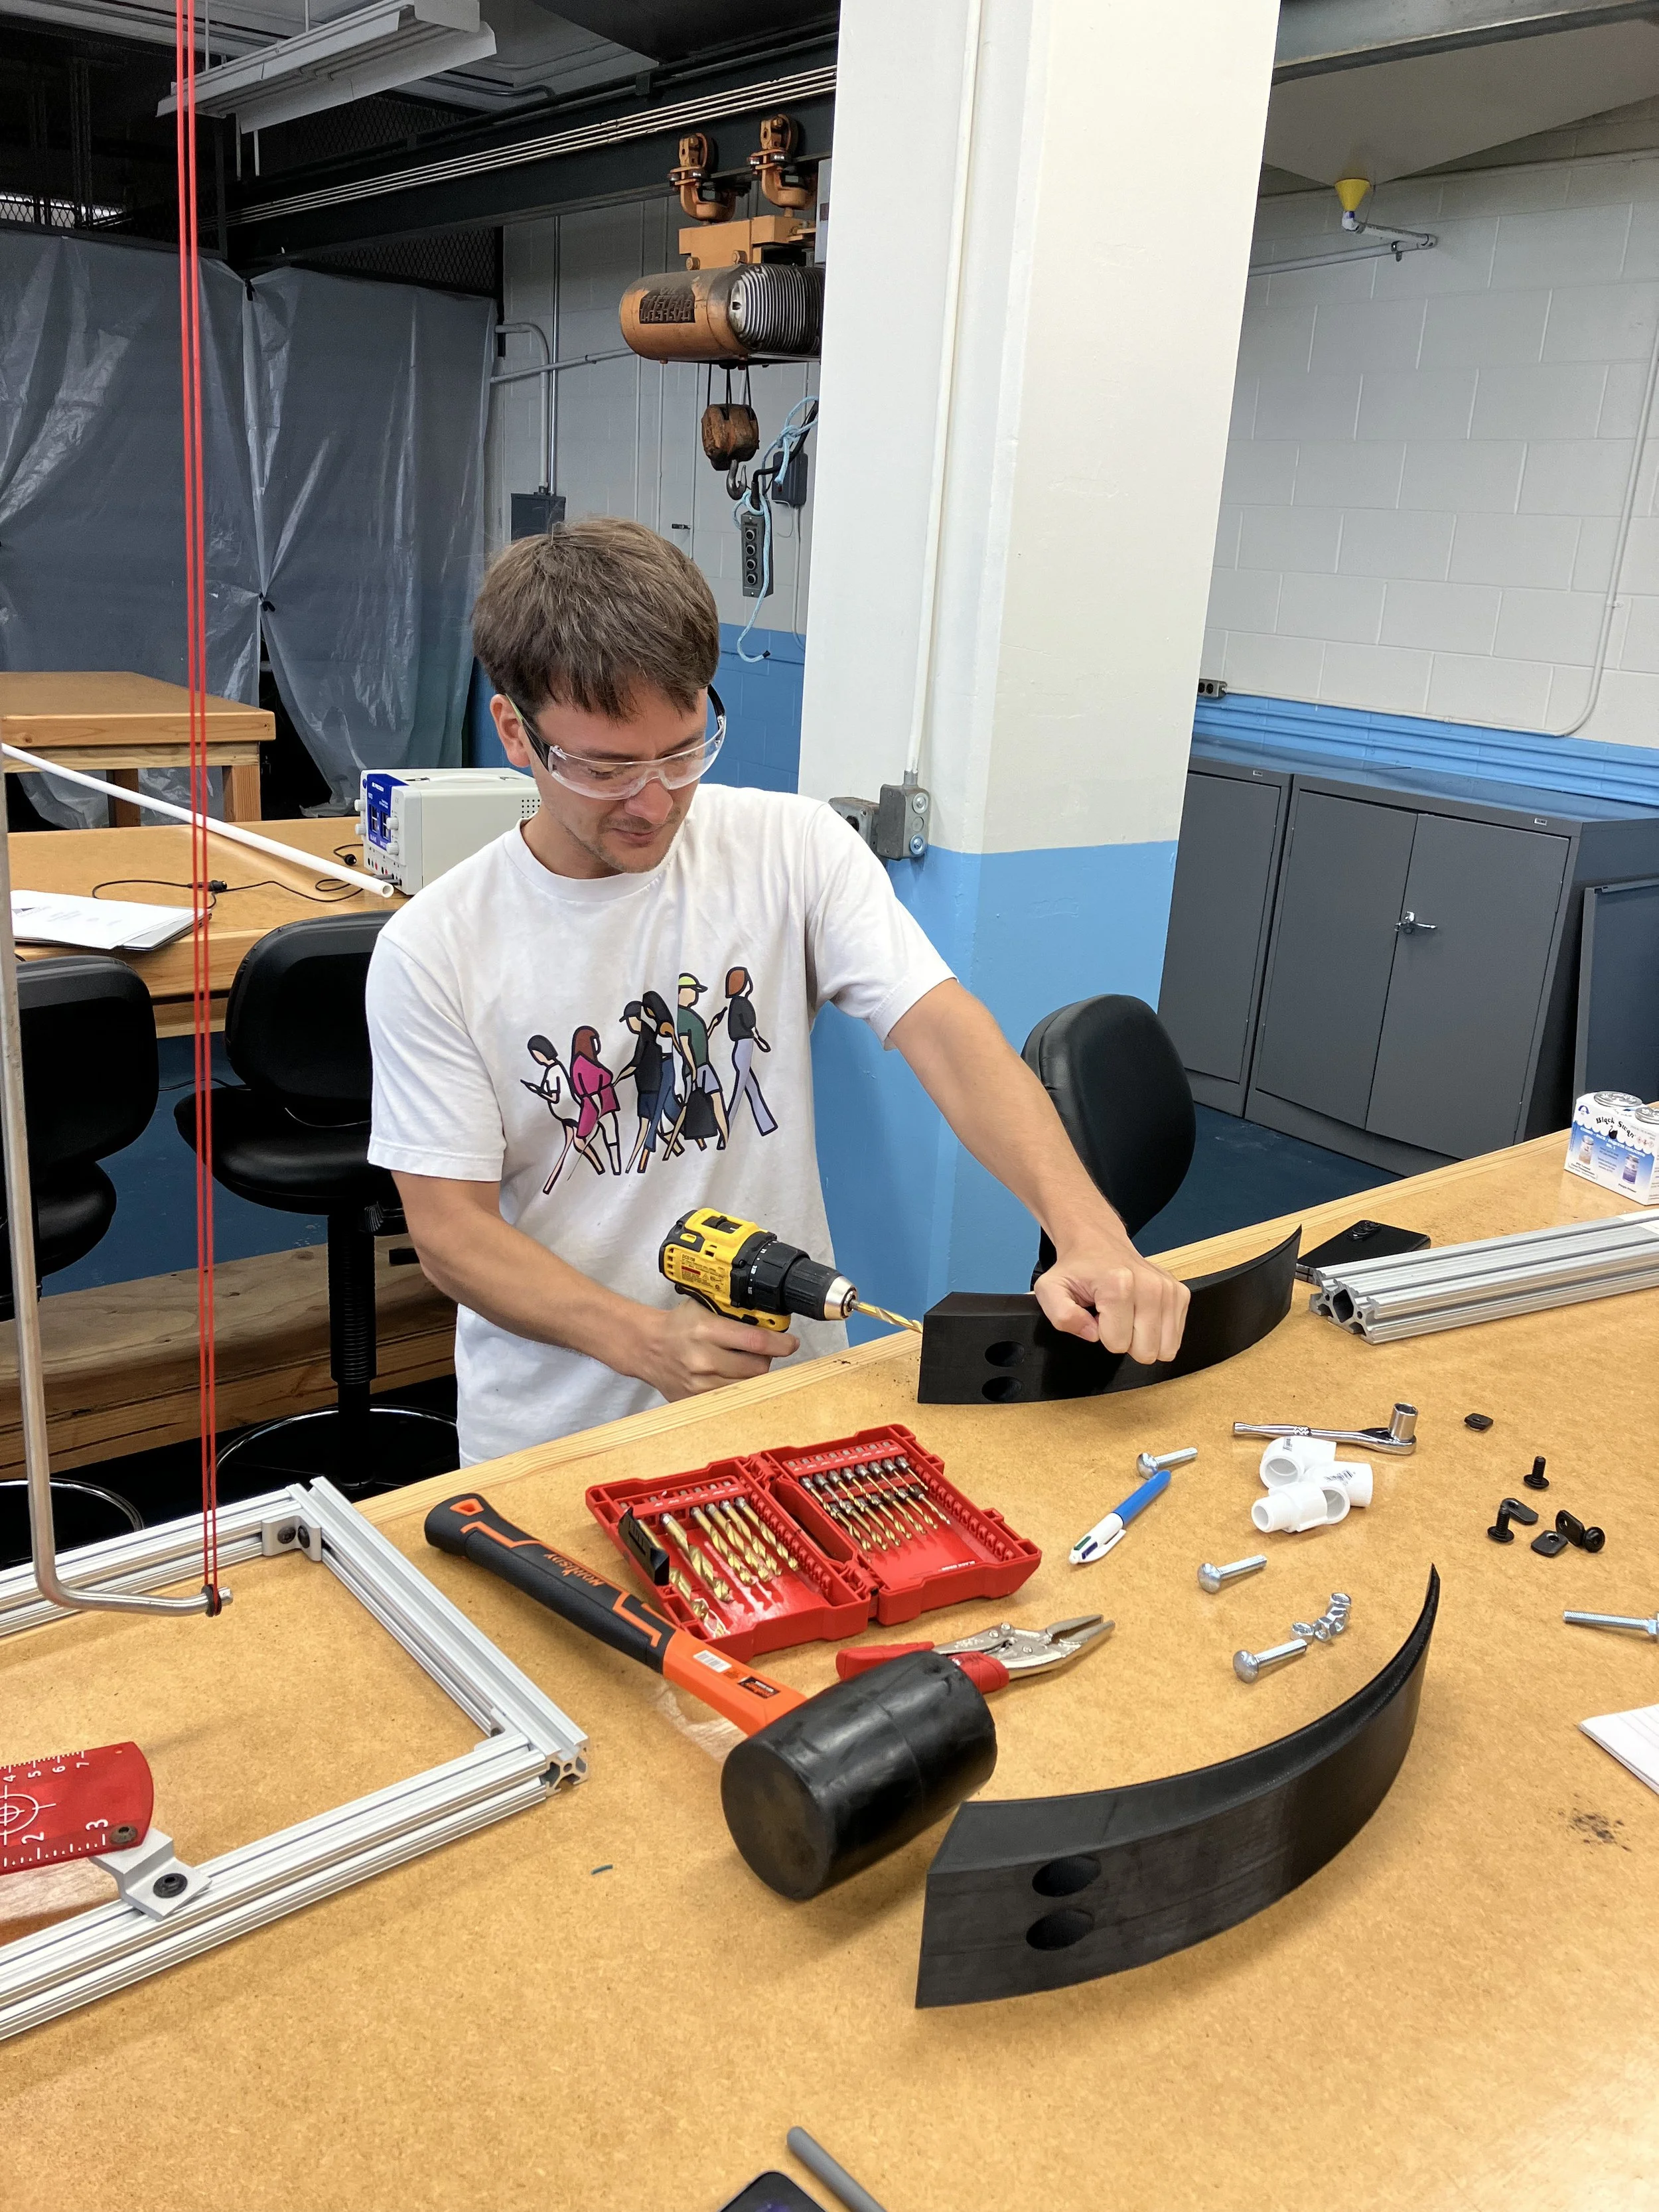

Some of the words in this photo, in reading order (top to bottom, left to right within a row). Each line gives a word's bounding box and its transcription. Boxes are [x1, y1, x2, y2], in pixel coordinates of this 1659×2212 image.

[1596, 1116, 1615, 1125] Black
[1617, 1121, 1635, 1138] Swan
[27, 1770, 41, 1779] 5
[21, 1832, 44, 1844] 2
[86, 1818, 109, 1830] 3
